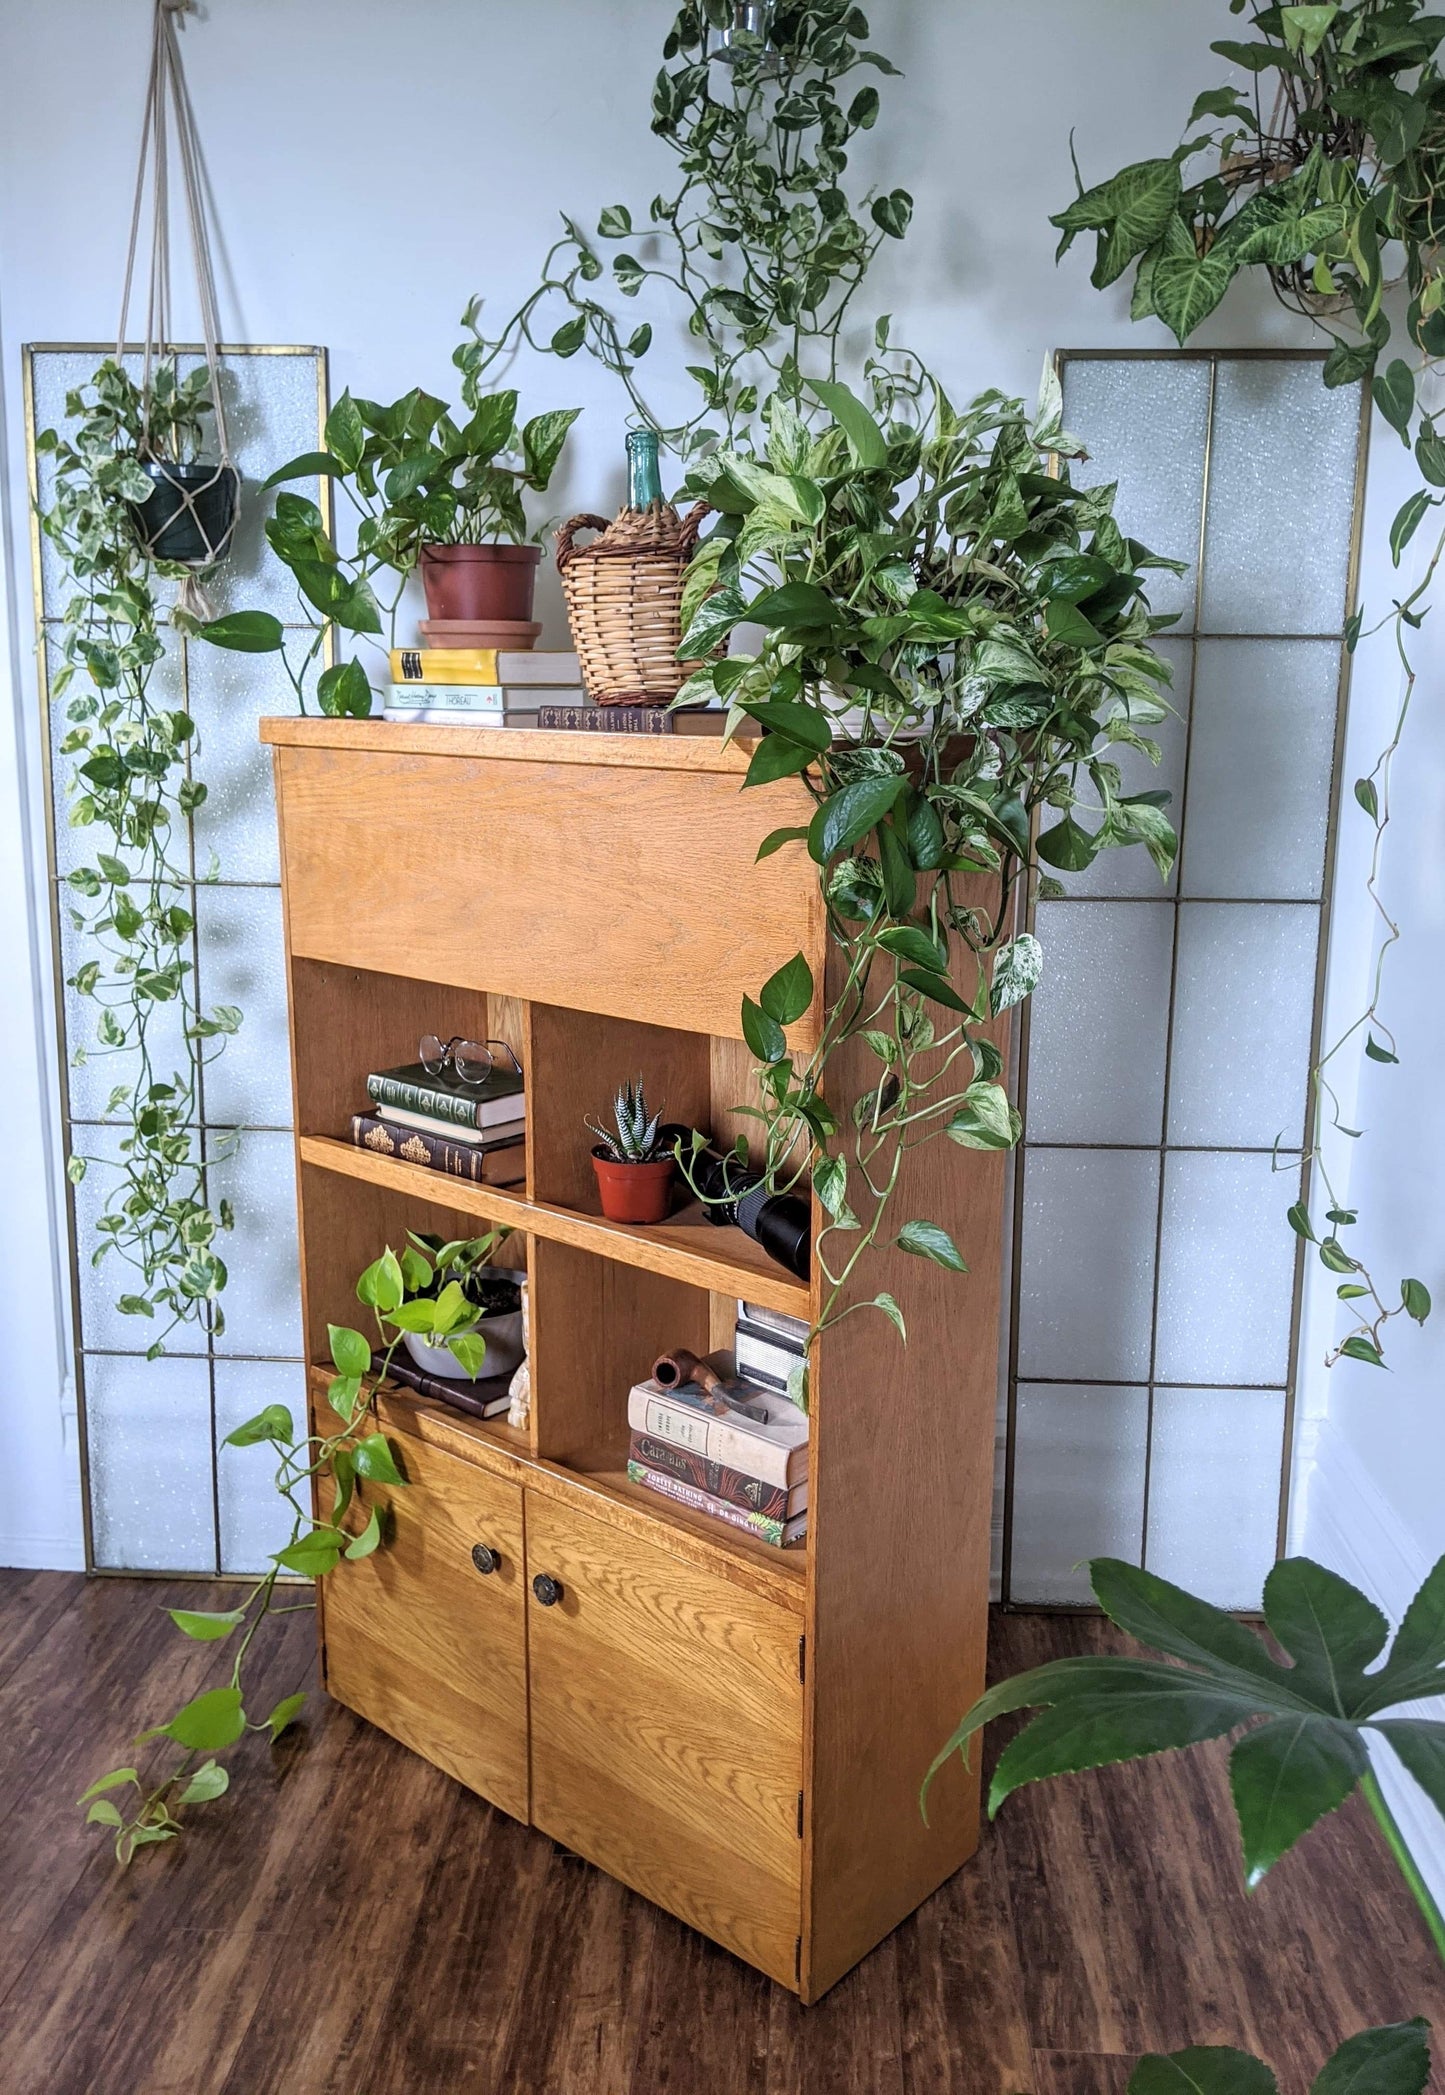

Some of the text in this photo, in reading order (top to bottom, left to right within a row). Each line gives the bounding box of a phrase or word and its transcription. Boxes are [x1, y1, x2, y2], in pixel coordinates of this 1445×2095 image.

[641, 1438, 687, 1470] Caraans
[647, 1472, 672, 1489] FOREST
[673, 1482, 703, 1502] BATHING
